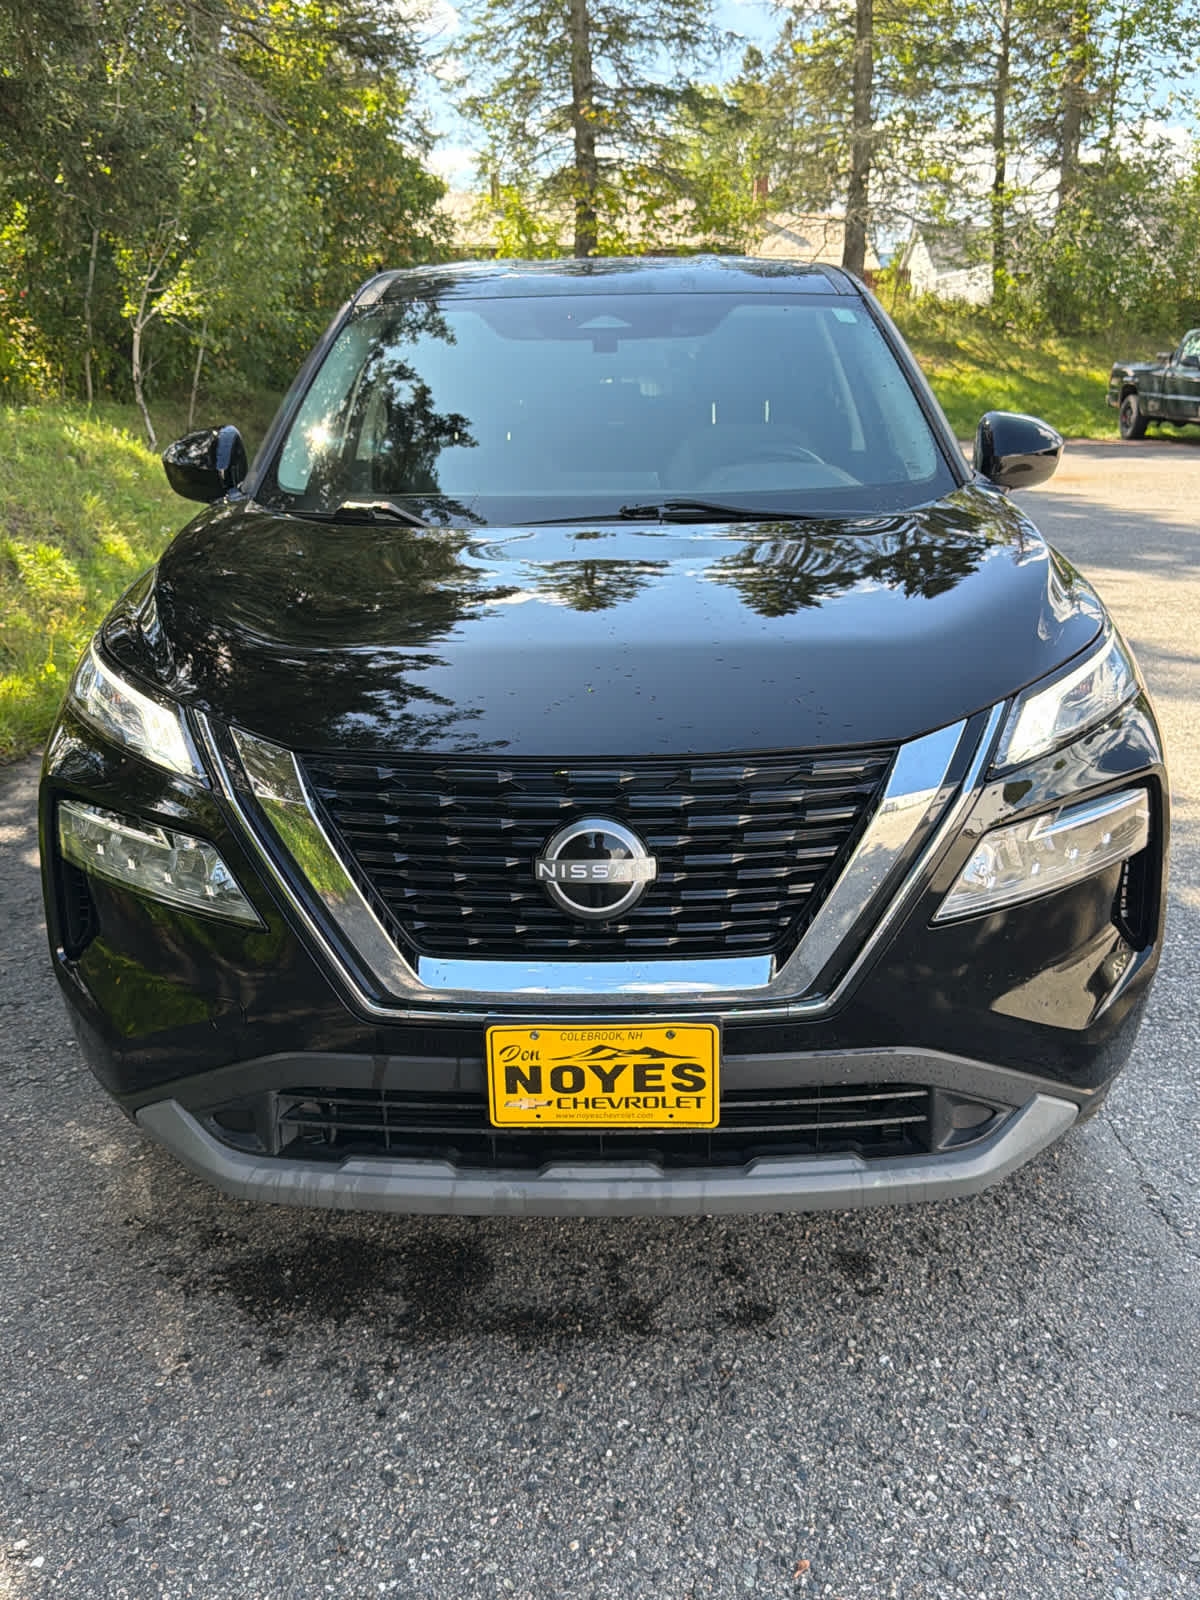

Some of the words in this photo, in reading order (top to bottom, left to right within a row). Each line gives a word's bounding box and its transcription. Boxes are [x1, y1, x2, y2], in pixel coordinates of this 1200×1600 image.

[539, 862, 652, 879] NISSA
[559, 1031, 625, 1042] COLEBROOK,
[627, 1031, 643, 1041] NH
[498, 1044, 541, 1063] Don
[504, 1062, 707, 1095] NOYES
[556, 1096, 707, 1110] CHEVROLET
[555, 1112, 654, 1120] www.noyeschevrolet.com
